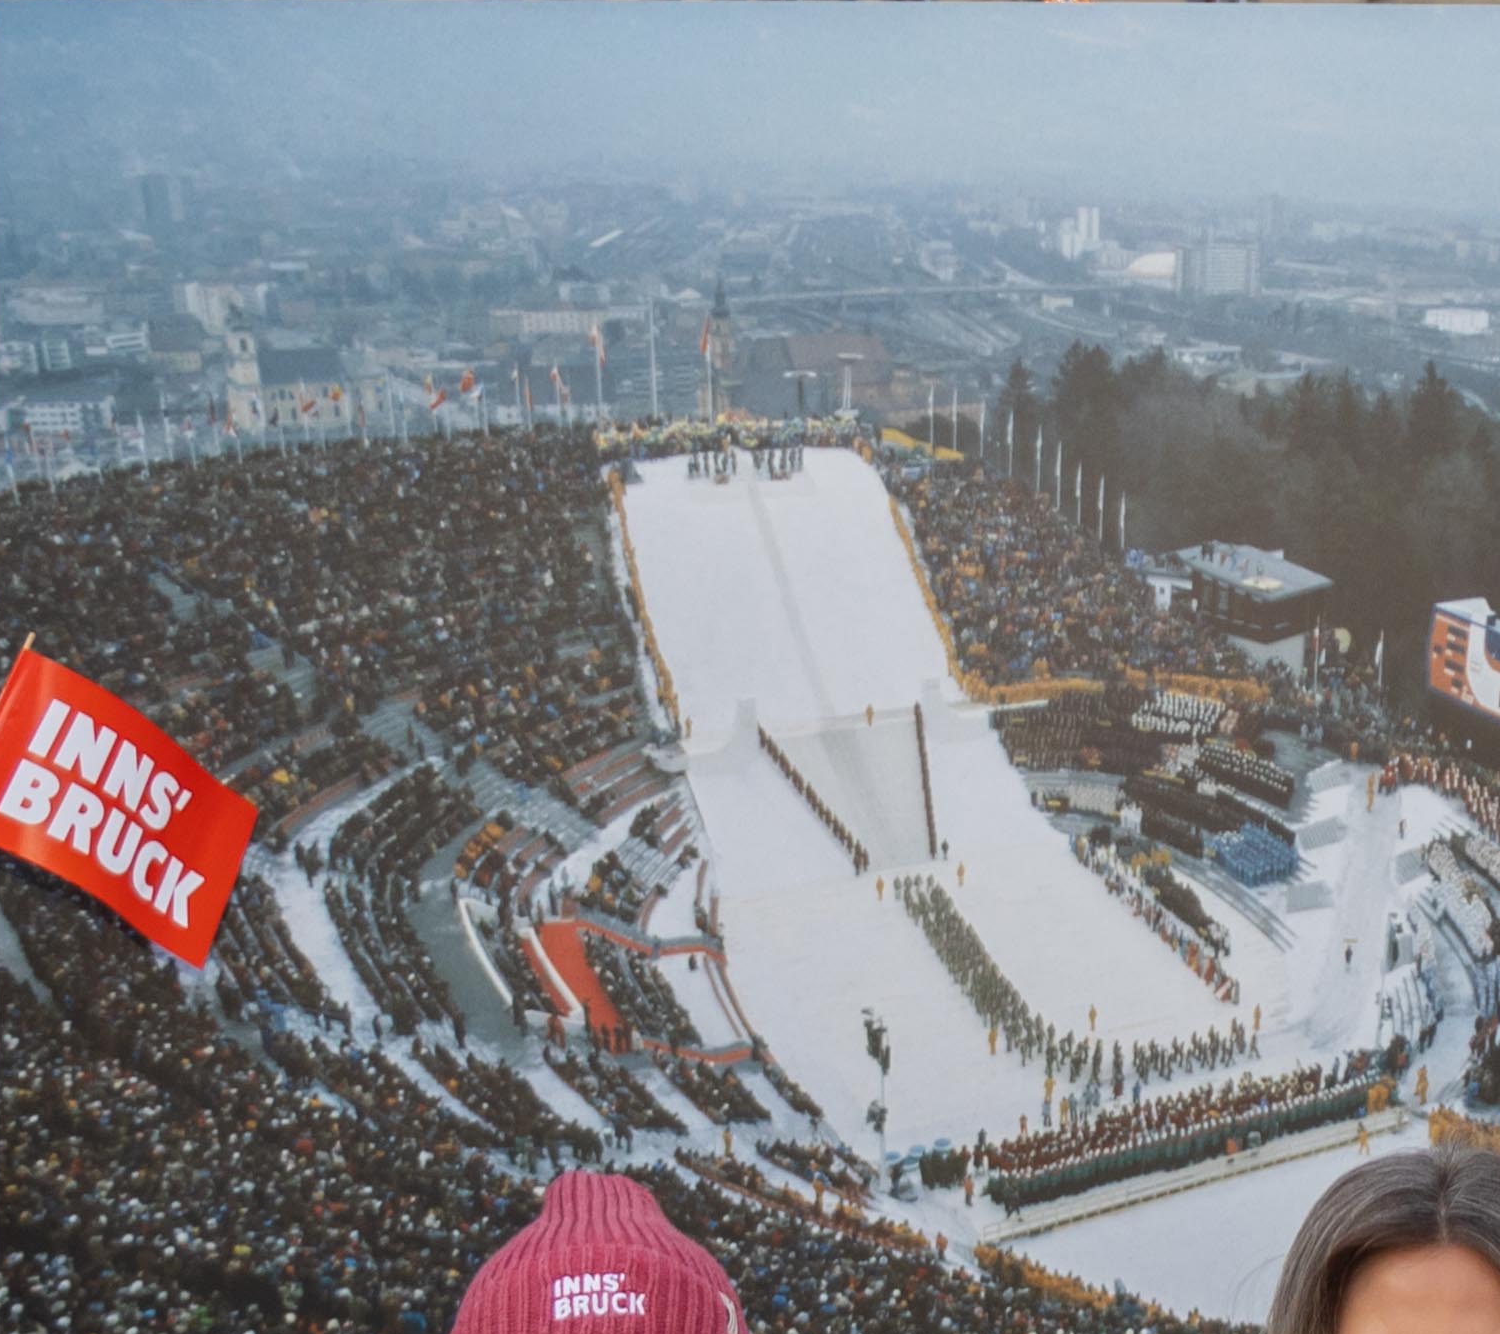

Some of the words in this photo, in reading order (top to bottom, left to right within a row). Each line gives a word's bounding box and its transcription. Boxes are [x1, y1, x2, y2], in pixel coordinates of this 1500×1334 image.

[27, 698, 193, 831] INNS'
[553, 1272, 626, 1298] INNS'
[553, 1292, 646, 1321] BRUCK
